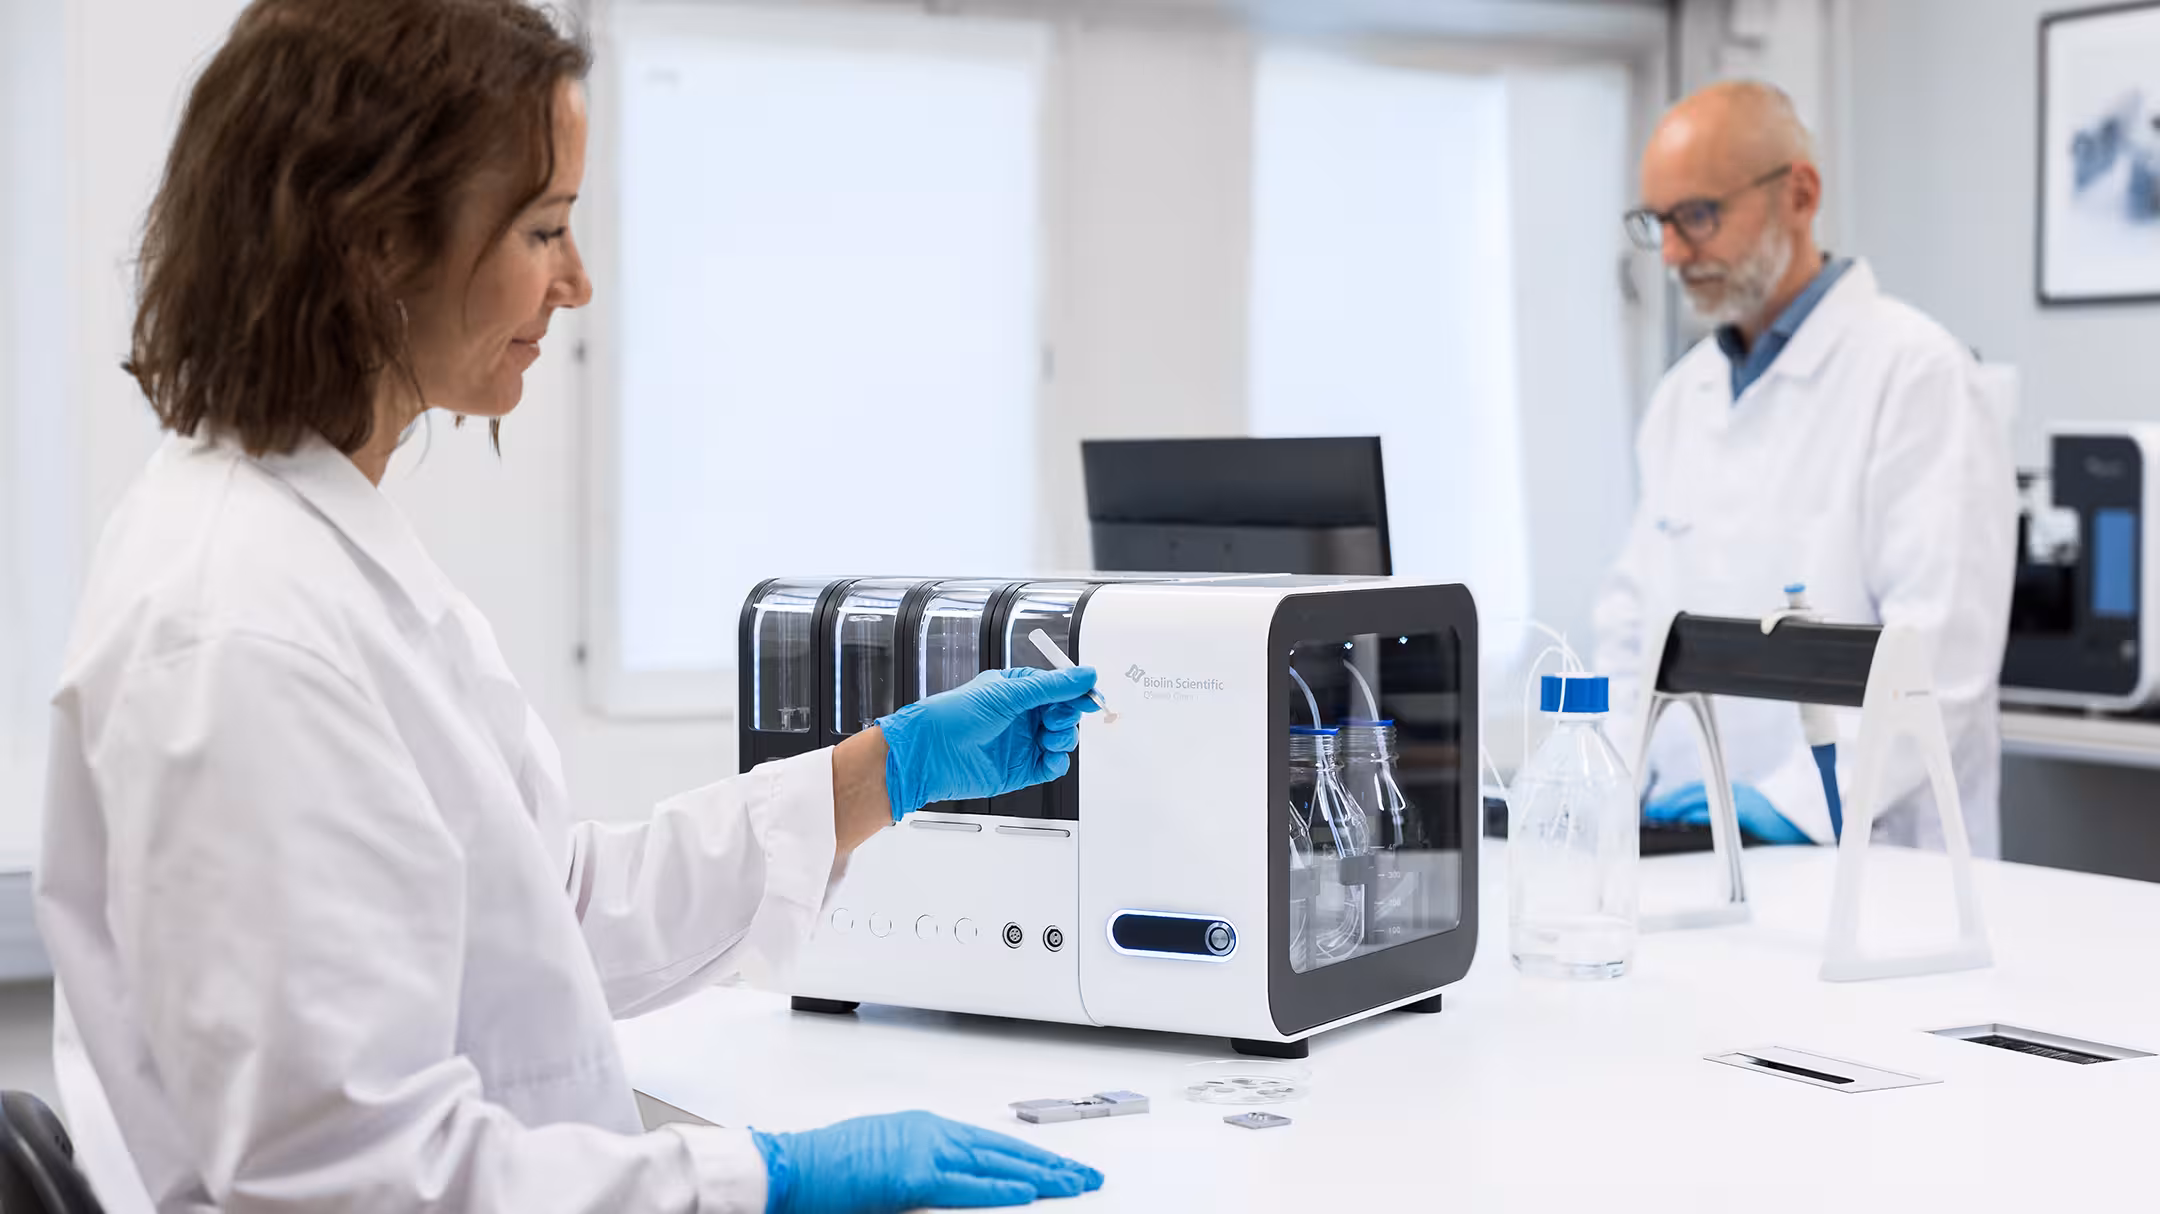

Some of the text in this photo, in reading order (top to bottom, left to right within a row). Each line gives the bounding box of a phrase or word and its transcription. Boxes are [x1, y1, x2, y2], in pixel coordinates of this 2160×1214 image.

[1143, 677, 1224, 691] Biolin Scientific
[1388, 926, 1401, 934] 100
